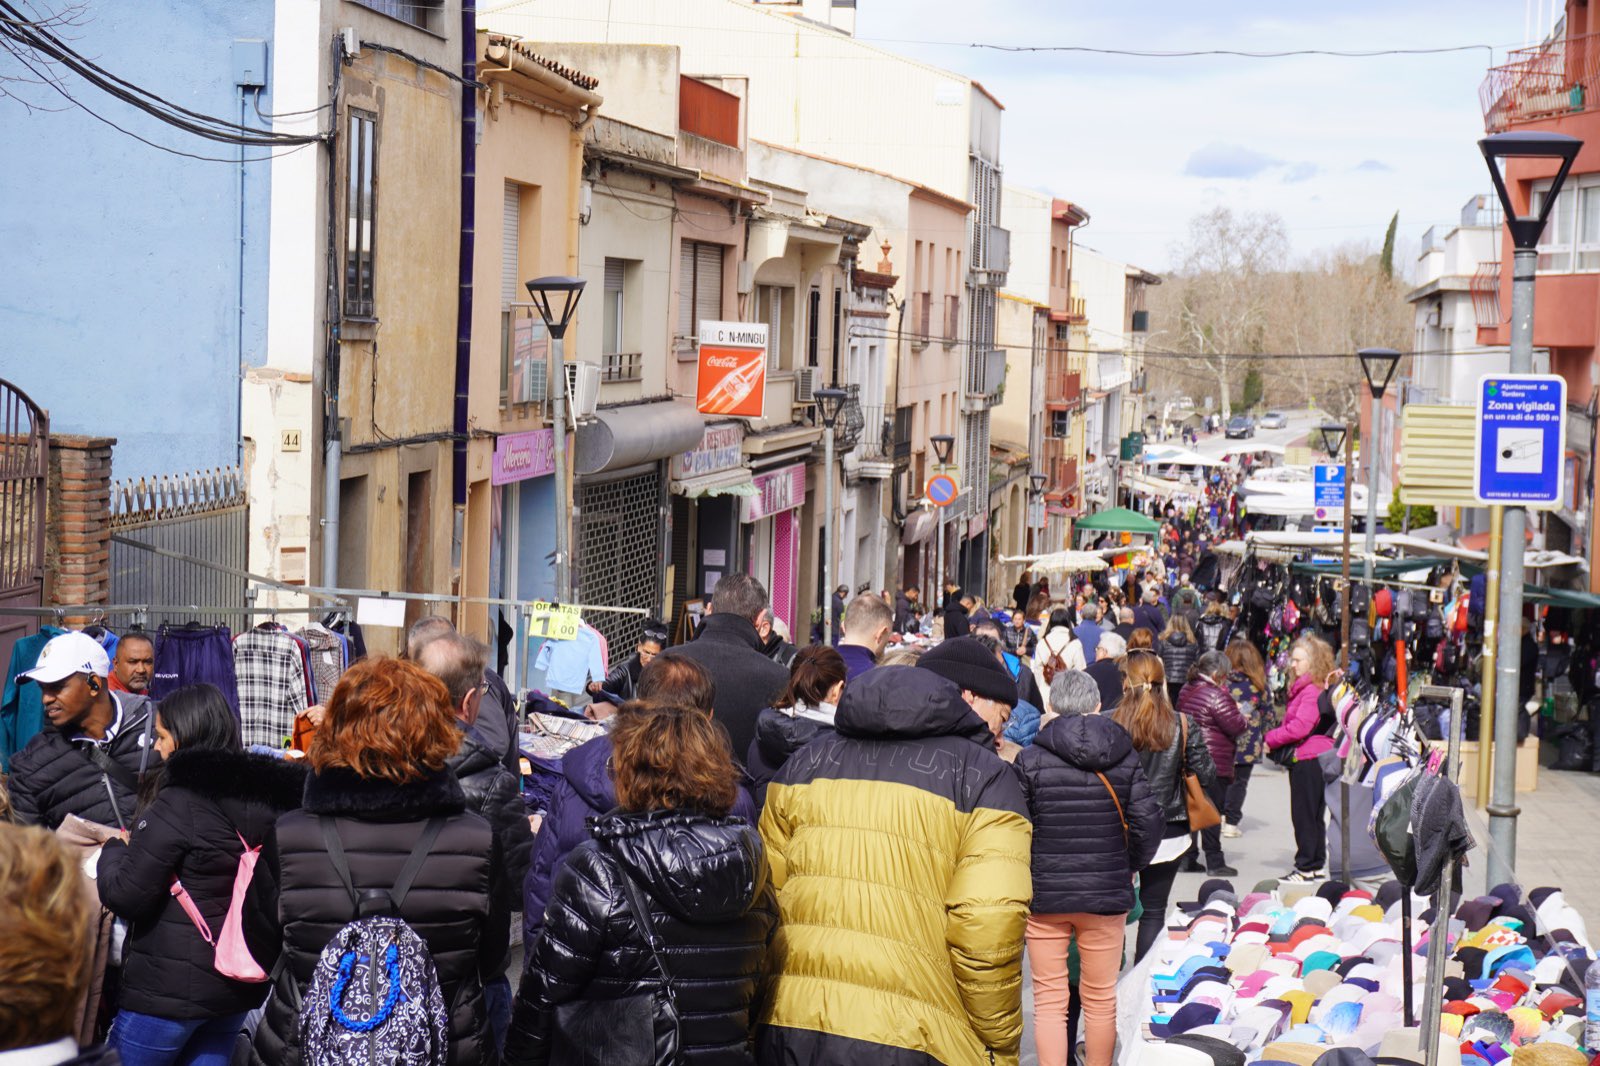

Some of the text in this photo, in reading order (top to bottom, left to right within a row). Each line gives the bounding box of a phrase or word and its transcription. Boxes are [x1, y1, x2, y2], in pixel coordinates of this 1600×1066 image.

[706, 355, 739, 368] Coca-Cola
[1501, 383, 1538, 392] Ajuntament
[1488, 400, 1555, 412] Zona vigilada
[1507, 413, 1523, 421] radi
[1524, 413, 1534, 421] de
[283, 433, 298, 447] 44
[1326, 466, 1339, 481] P
